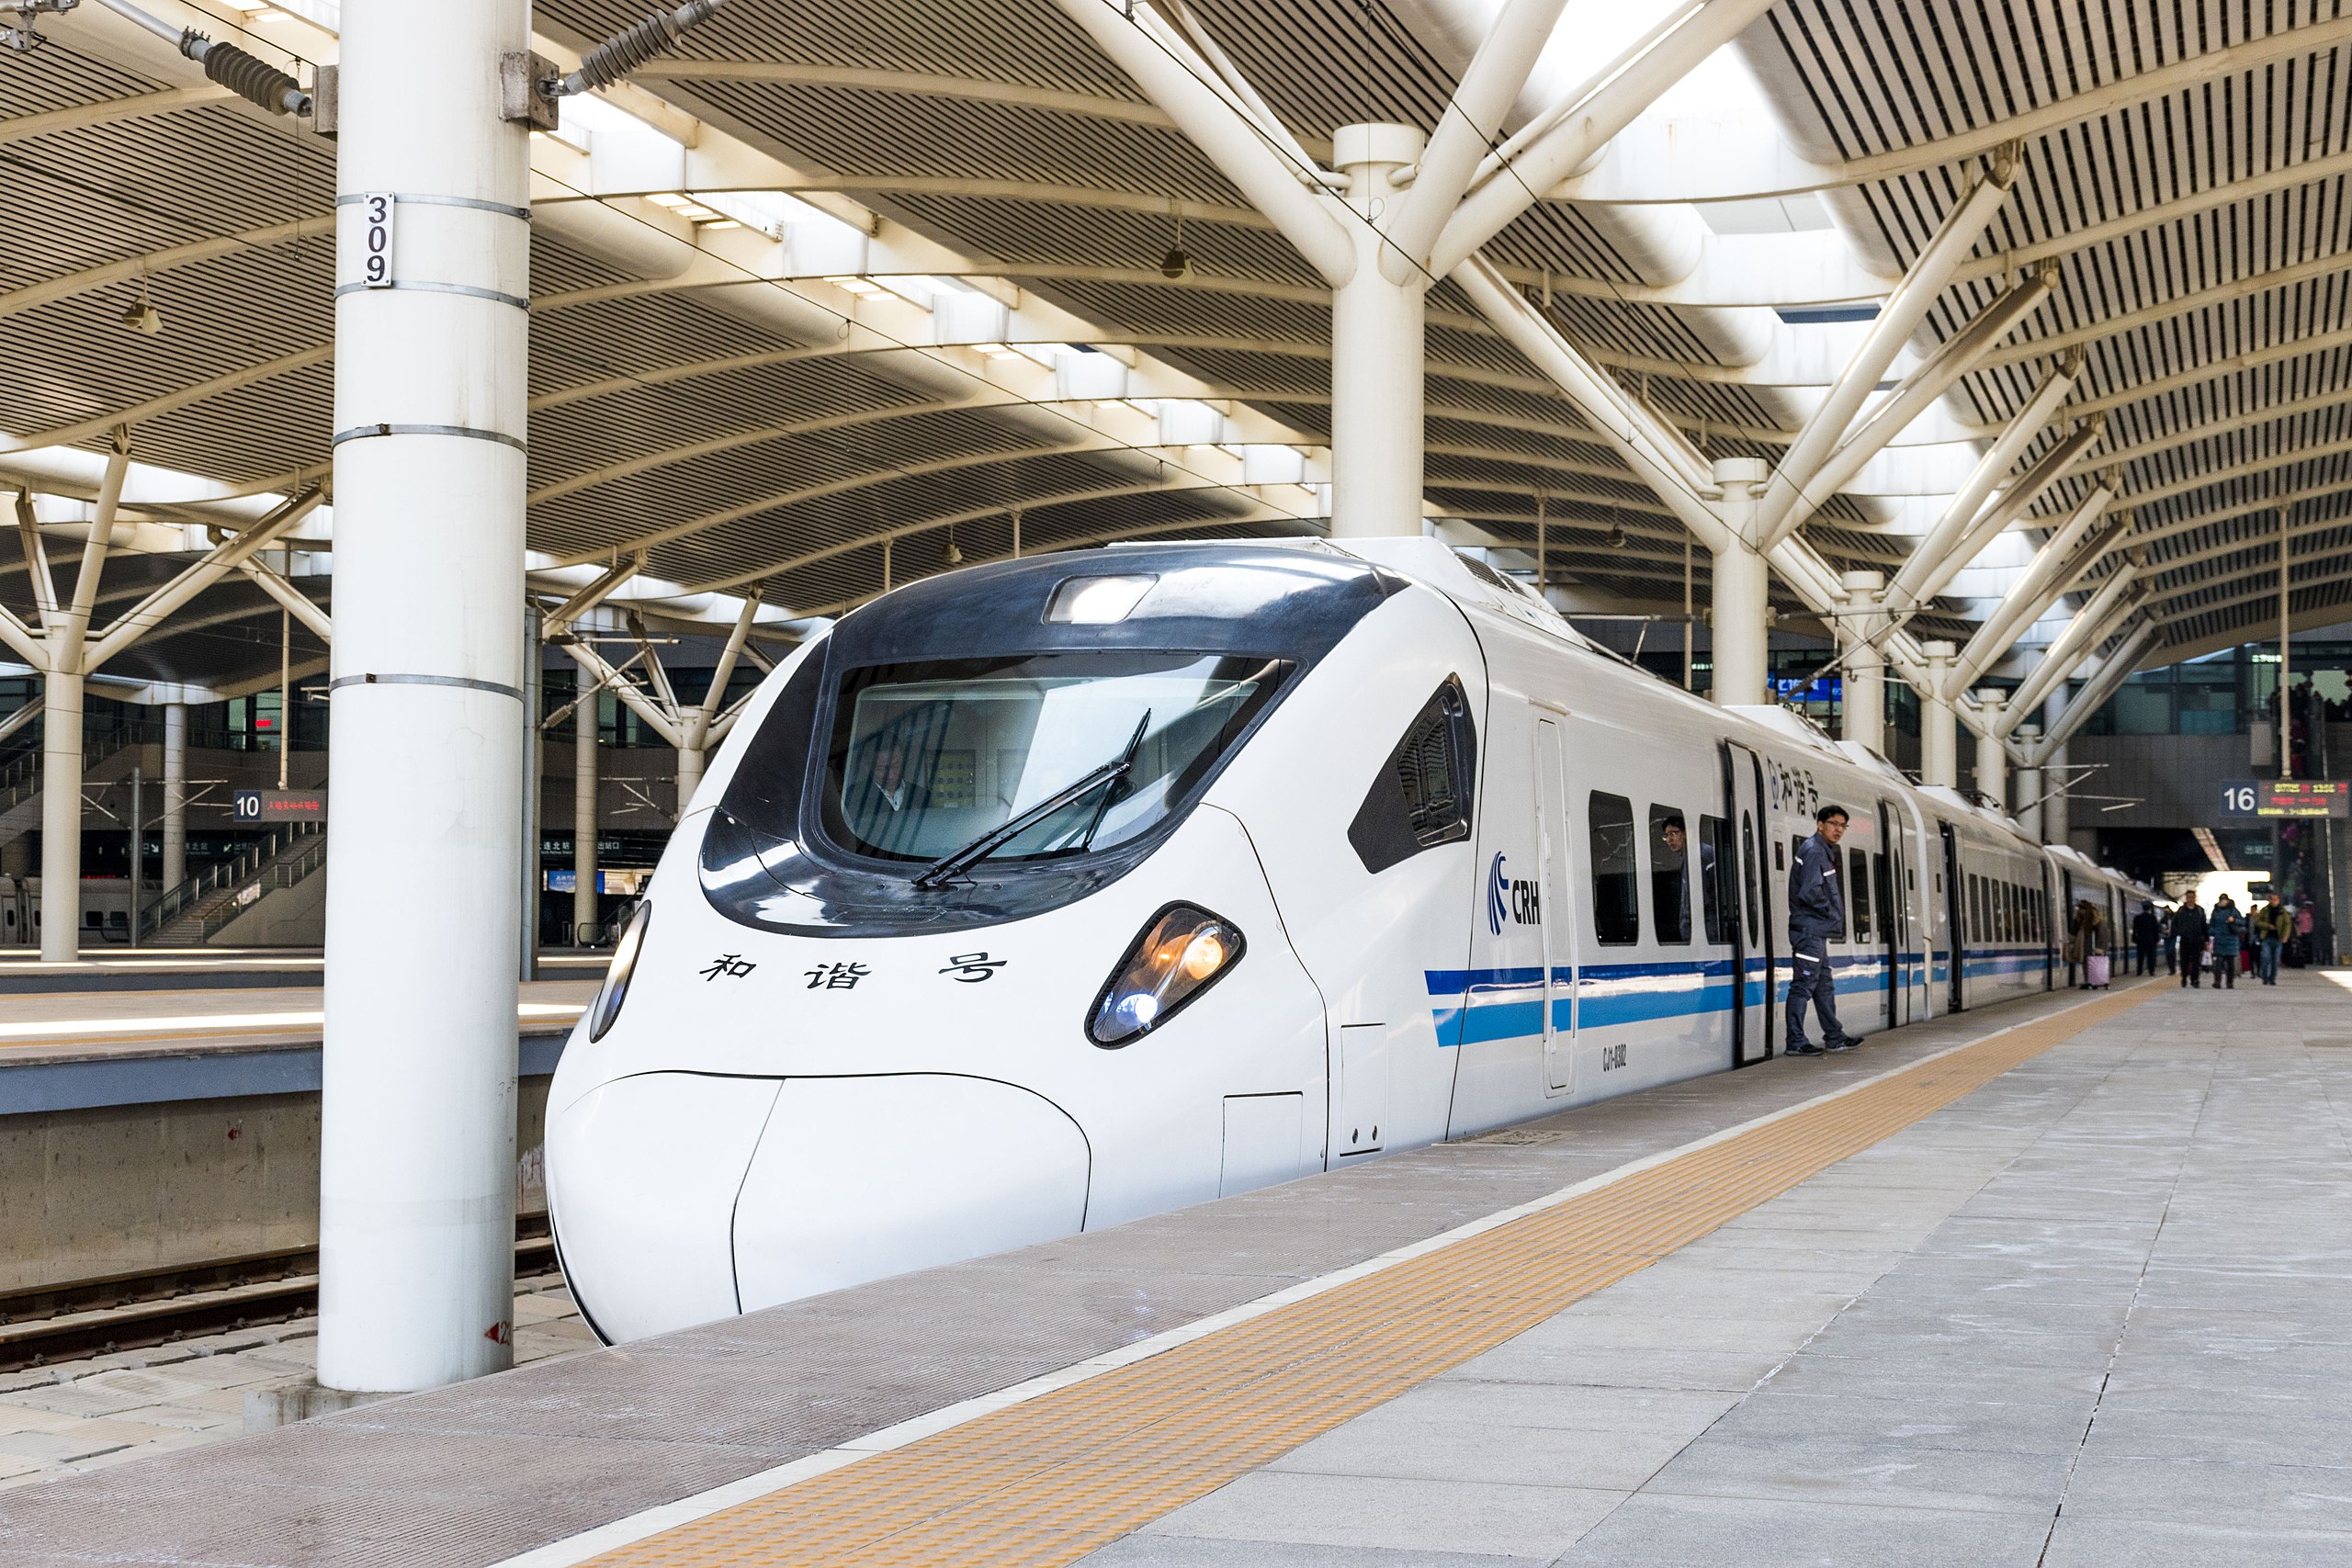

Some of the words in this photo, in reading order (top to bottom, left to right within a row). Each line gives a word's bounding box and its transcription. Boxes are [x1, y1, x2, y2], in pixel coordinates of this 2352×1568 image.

[367, 197, 387, 282] 309
[236, 796, 259, 817] 10
[1778, 762, 1818, 820] 和谐号
[2223, 787, 2256, 811] 16
[1512, 879, 1541, 925] CRH
[699, 952, 1008, 990] 和谐号
